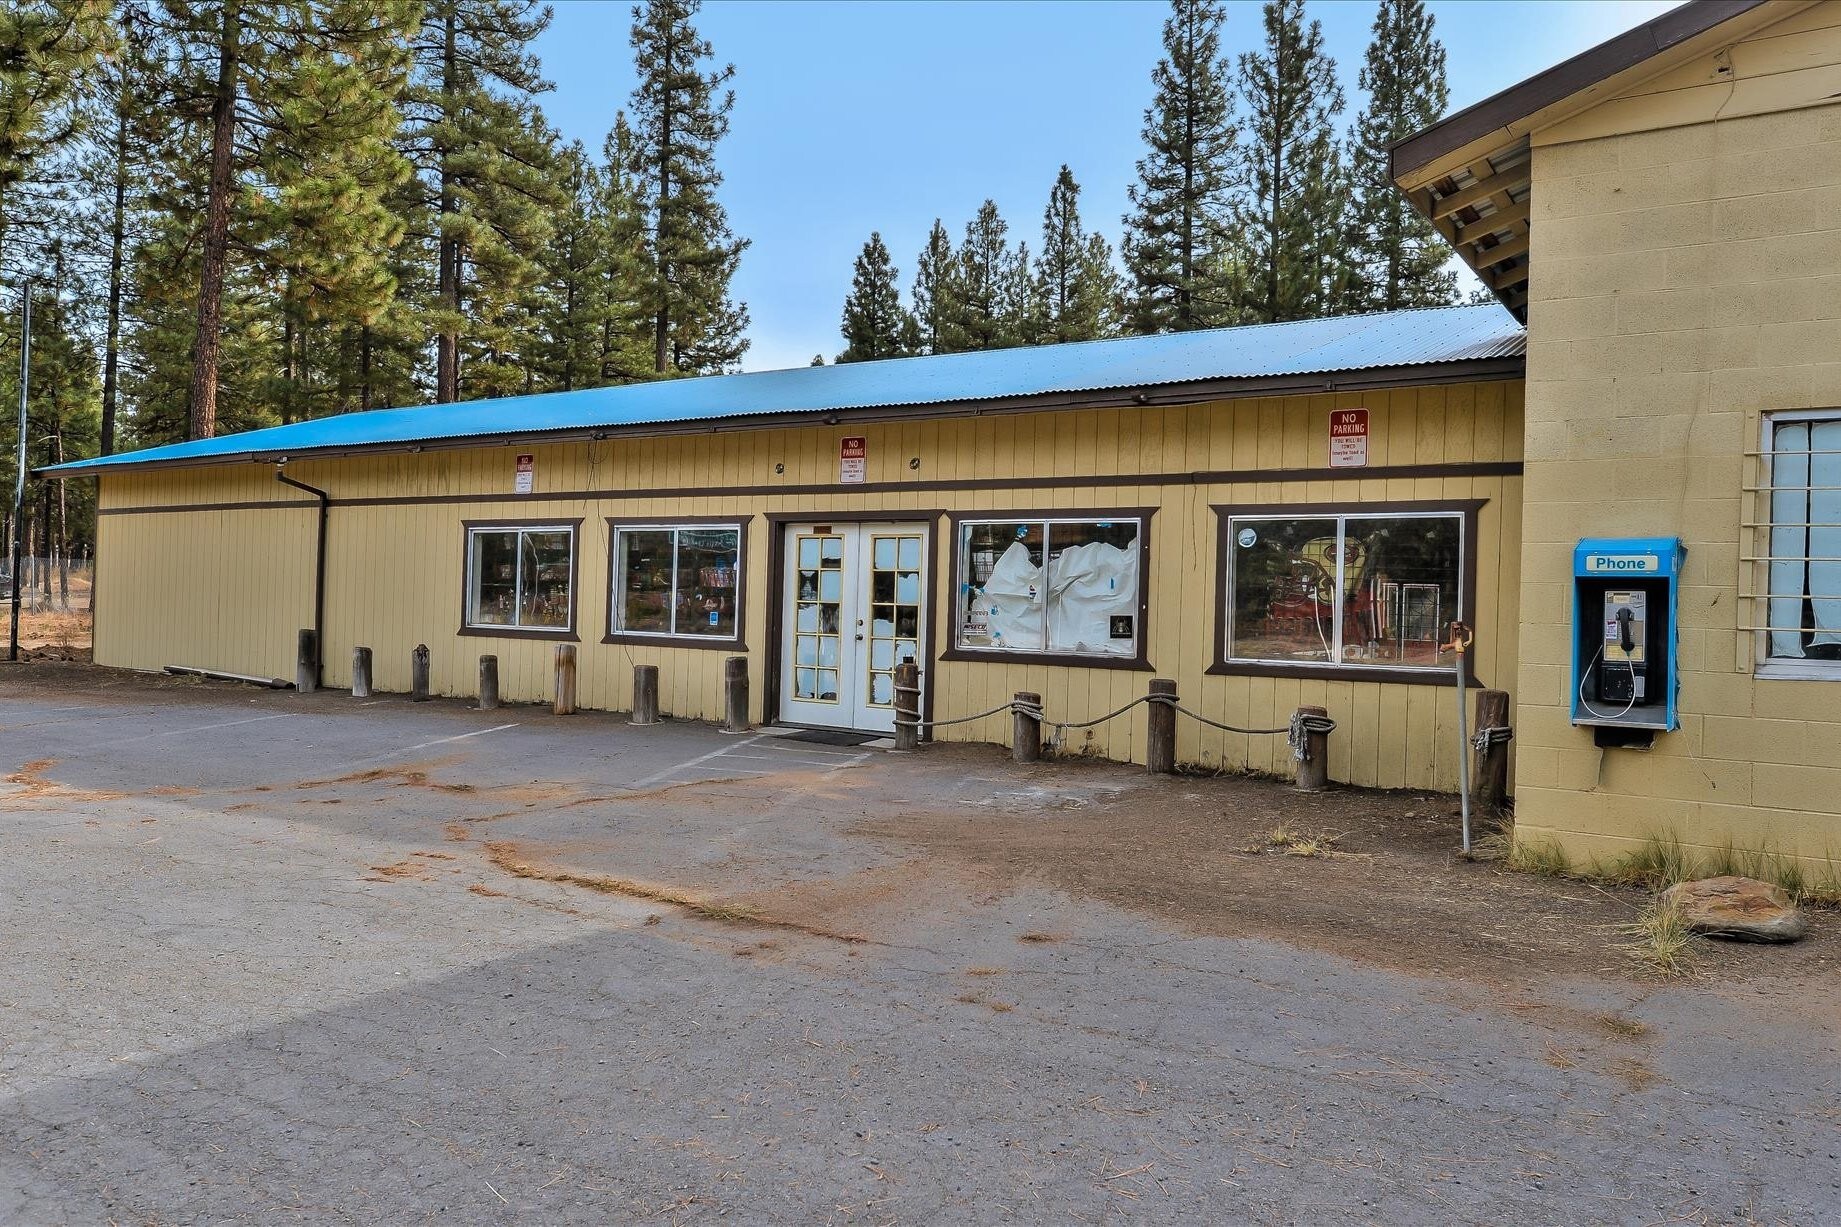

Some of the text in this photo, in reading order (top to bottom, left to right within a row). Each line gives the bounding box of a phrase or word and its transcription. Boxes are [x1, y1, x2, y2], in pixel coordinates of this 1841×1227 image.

[1342, 413, 1356, 423] NO
[1333, 424, 1365, 434] PARKING
[1596, 557, 1646, 570] Phone
